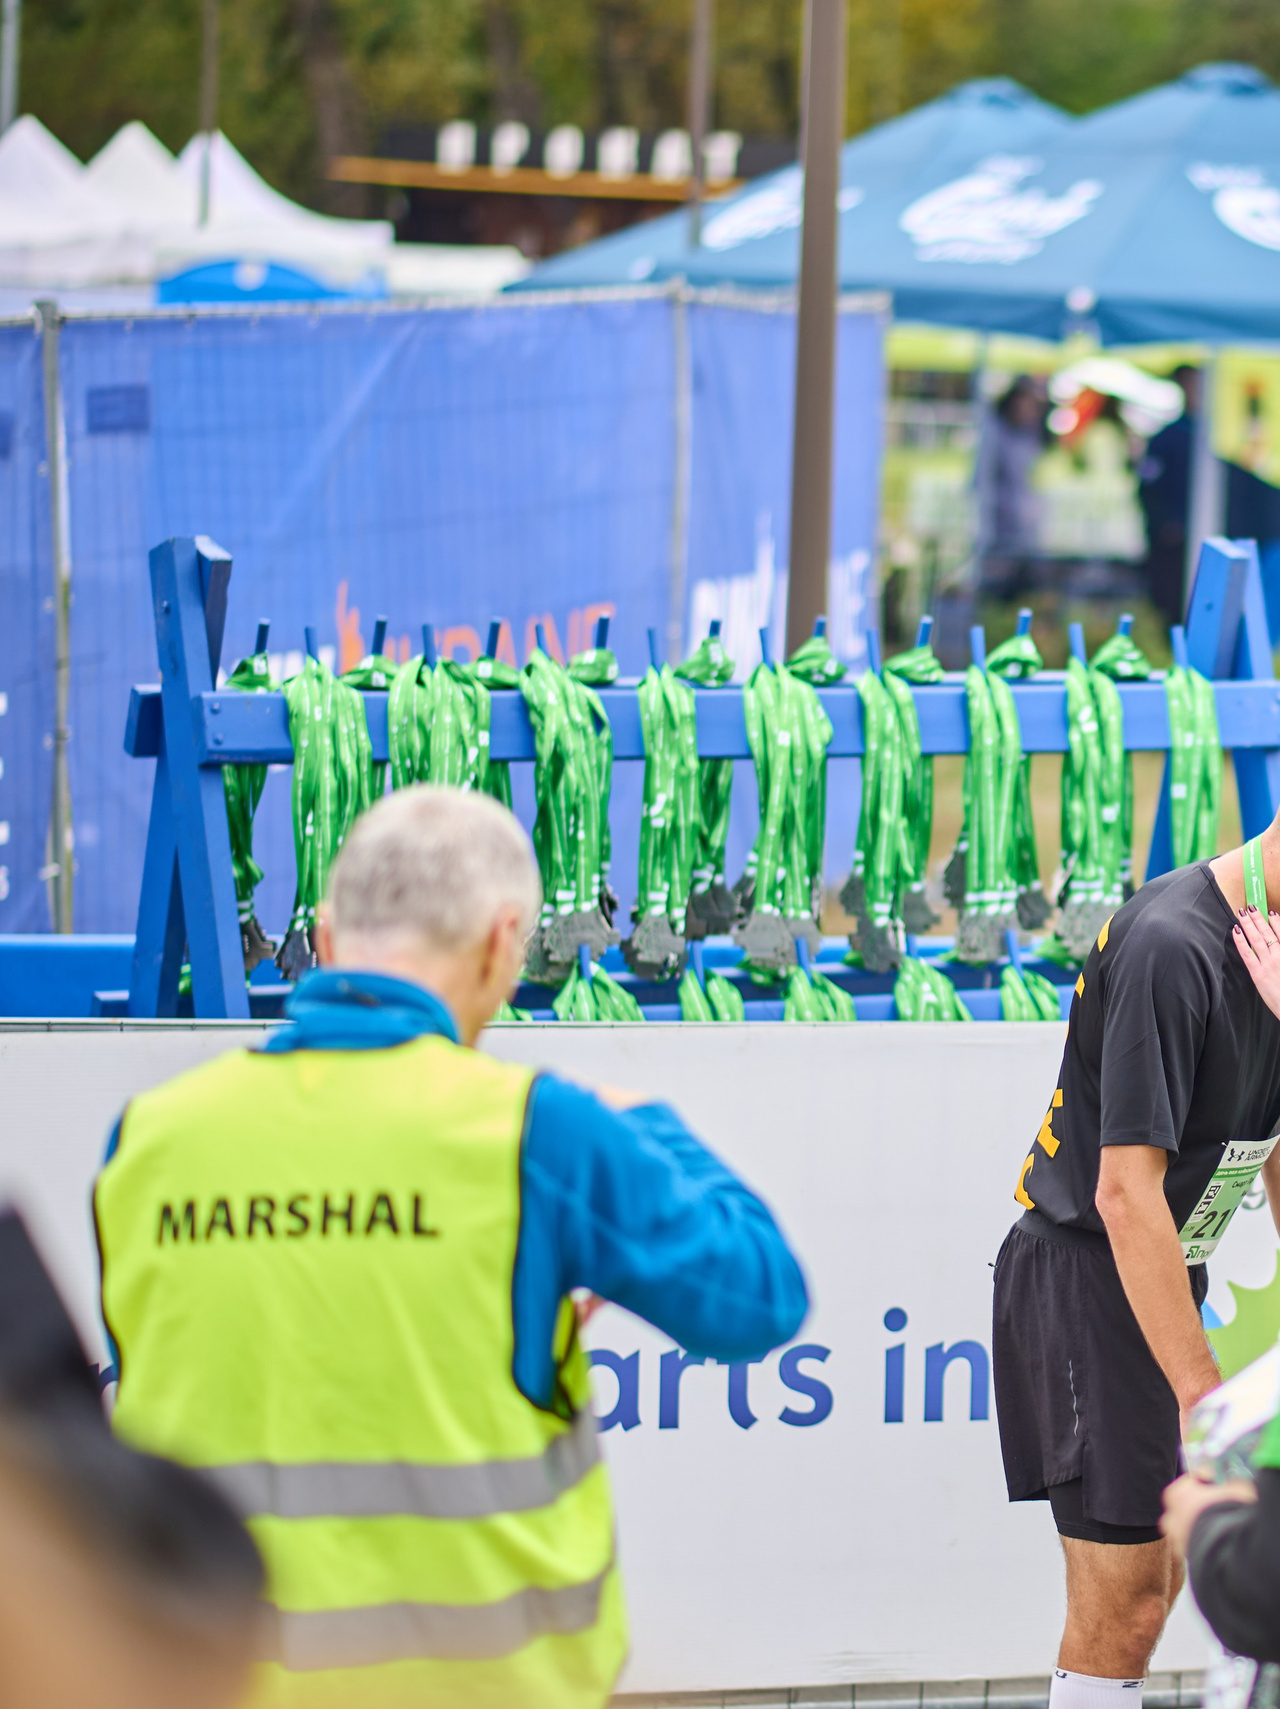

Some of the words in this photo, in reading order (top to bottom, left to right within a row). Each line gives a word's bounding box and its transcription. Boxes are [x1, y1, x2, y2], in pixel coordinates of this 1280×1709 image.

[156, 1192, 441, 1247] MARSHAL
[1191, 1208, 1233, 1239] 21
[585, 1342, 834, 1434] arts
[884, 1306, 991, 1424] in
